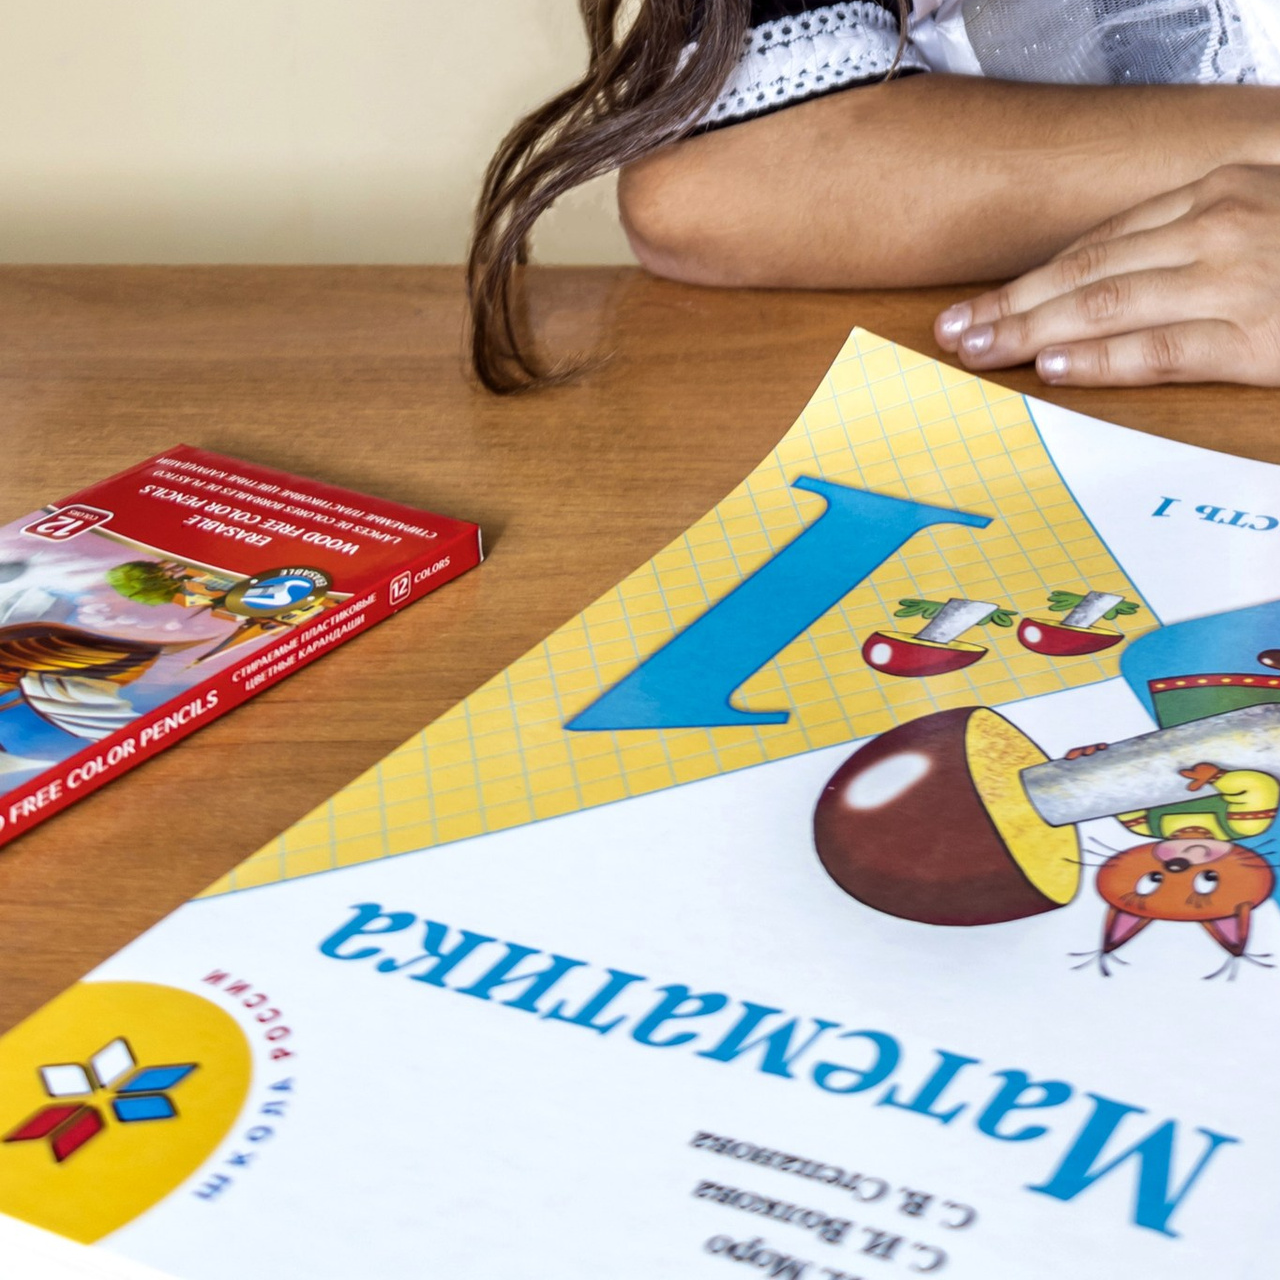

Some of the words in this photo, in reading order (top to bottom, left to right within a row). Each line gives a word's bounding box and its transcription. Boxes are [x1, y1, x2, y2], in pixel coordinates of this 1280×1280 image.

[156, 457, 228, 480] КАРАНДАШИ
[139, 484, 208, 509] PENCILS
[204, 482, 223, 493] DE
[220, 487, 286, 511] BORRABLES
[203, 501, 262, 525] COLOR
[283, 505, 336, 525] COLORES
[1151, 496, 1182, 518] 1
[36, 515, 84, 537] 12
[183, 514, 273, 546] ERASABLE
[257, 517, 305, 538] FREE
[334, 519, 355, 531] DE
[363, 512, 438, 539] СТИРАЕМЫЕ
[302, 531, 360, 556] WOOD
[280, 568, 328, 588] ERASABLE
[391, 577, 409, 600] 12
[413, 555, 451, 584] COLORS
[562, 473, 994, 732] 1
[231, 635, 300, 683] СТИРАЕМЫЕ
[300, 592, 378, 644] ПЛАСТИКОВЫЕ
[244, 654, 297, 692] ЦВЕТНЫЕ
[297, 613, 366, 660] КАРАНДАШИ
[9, 779, 63, 825] FREE
[66, 738, 136, 789] COLOR
[140, 689, 219, 748] PENCILS
[200, 968, 296, 1062] РОССИИ
[318, 901, 1242, 1238] Математика
[190, 1075, 296, 1202] ШКОЛА
[689, 1130, 891, 1203] Степанова
[690, 1179, 854, 1246] Волкова
[898, 1186, 935, 1218] В.
[939, 1198, 979, 1231] С.
[860, 1225, 906, 1262] И.
[908, 1241, 949, 1274] С.
